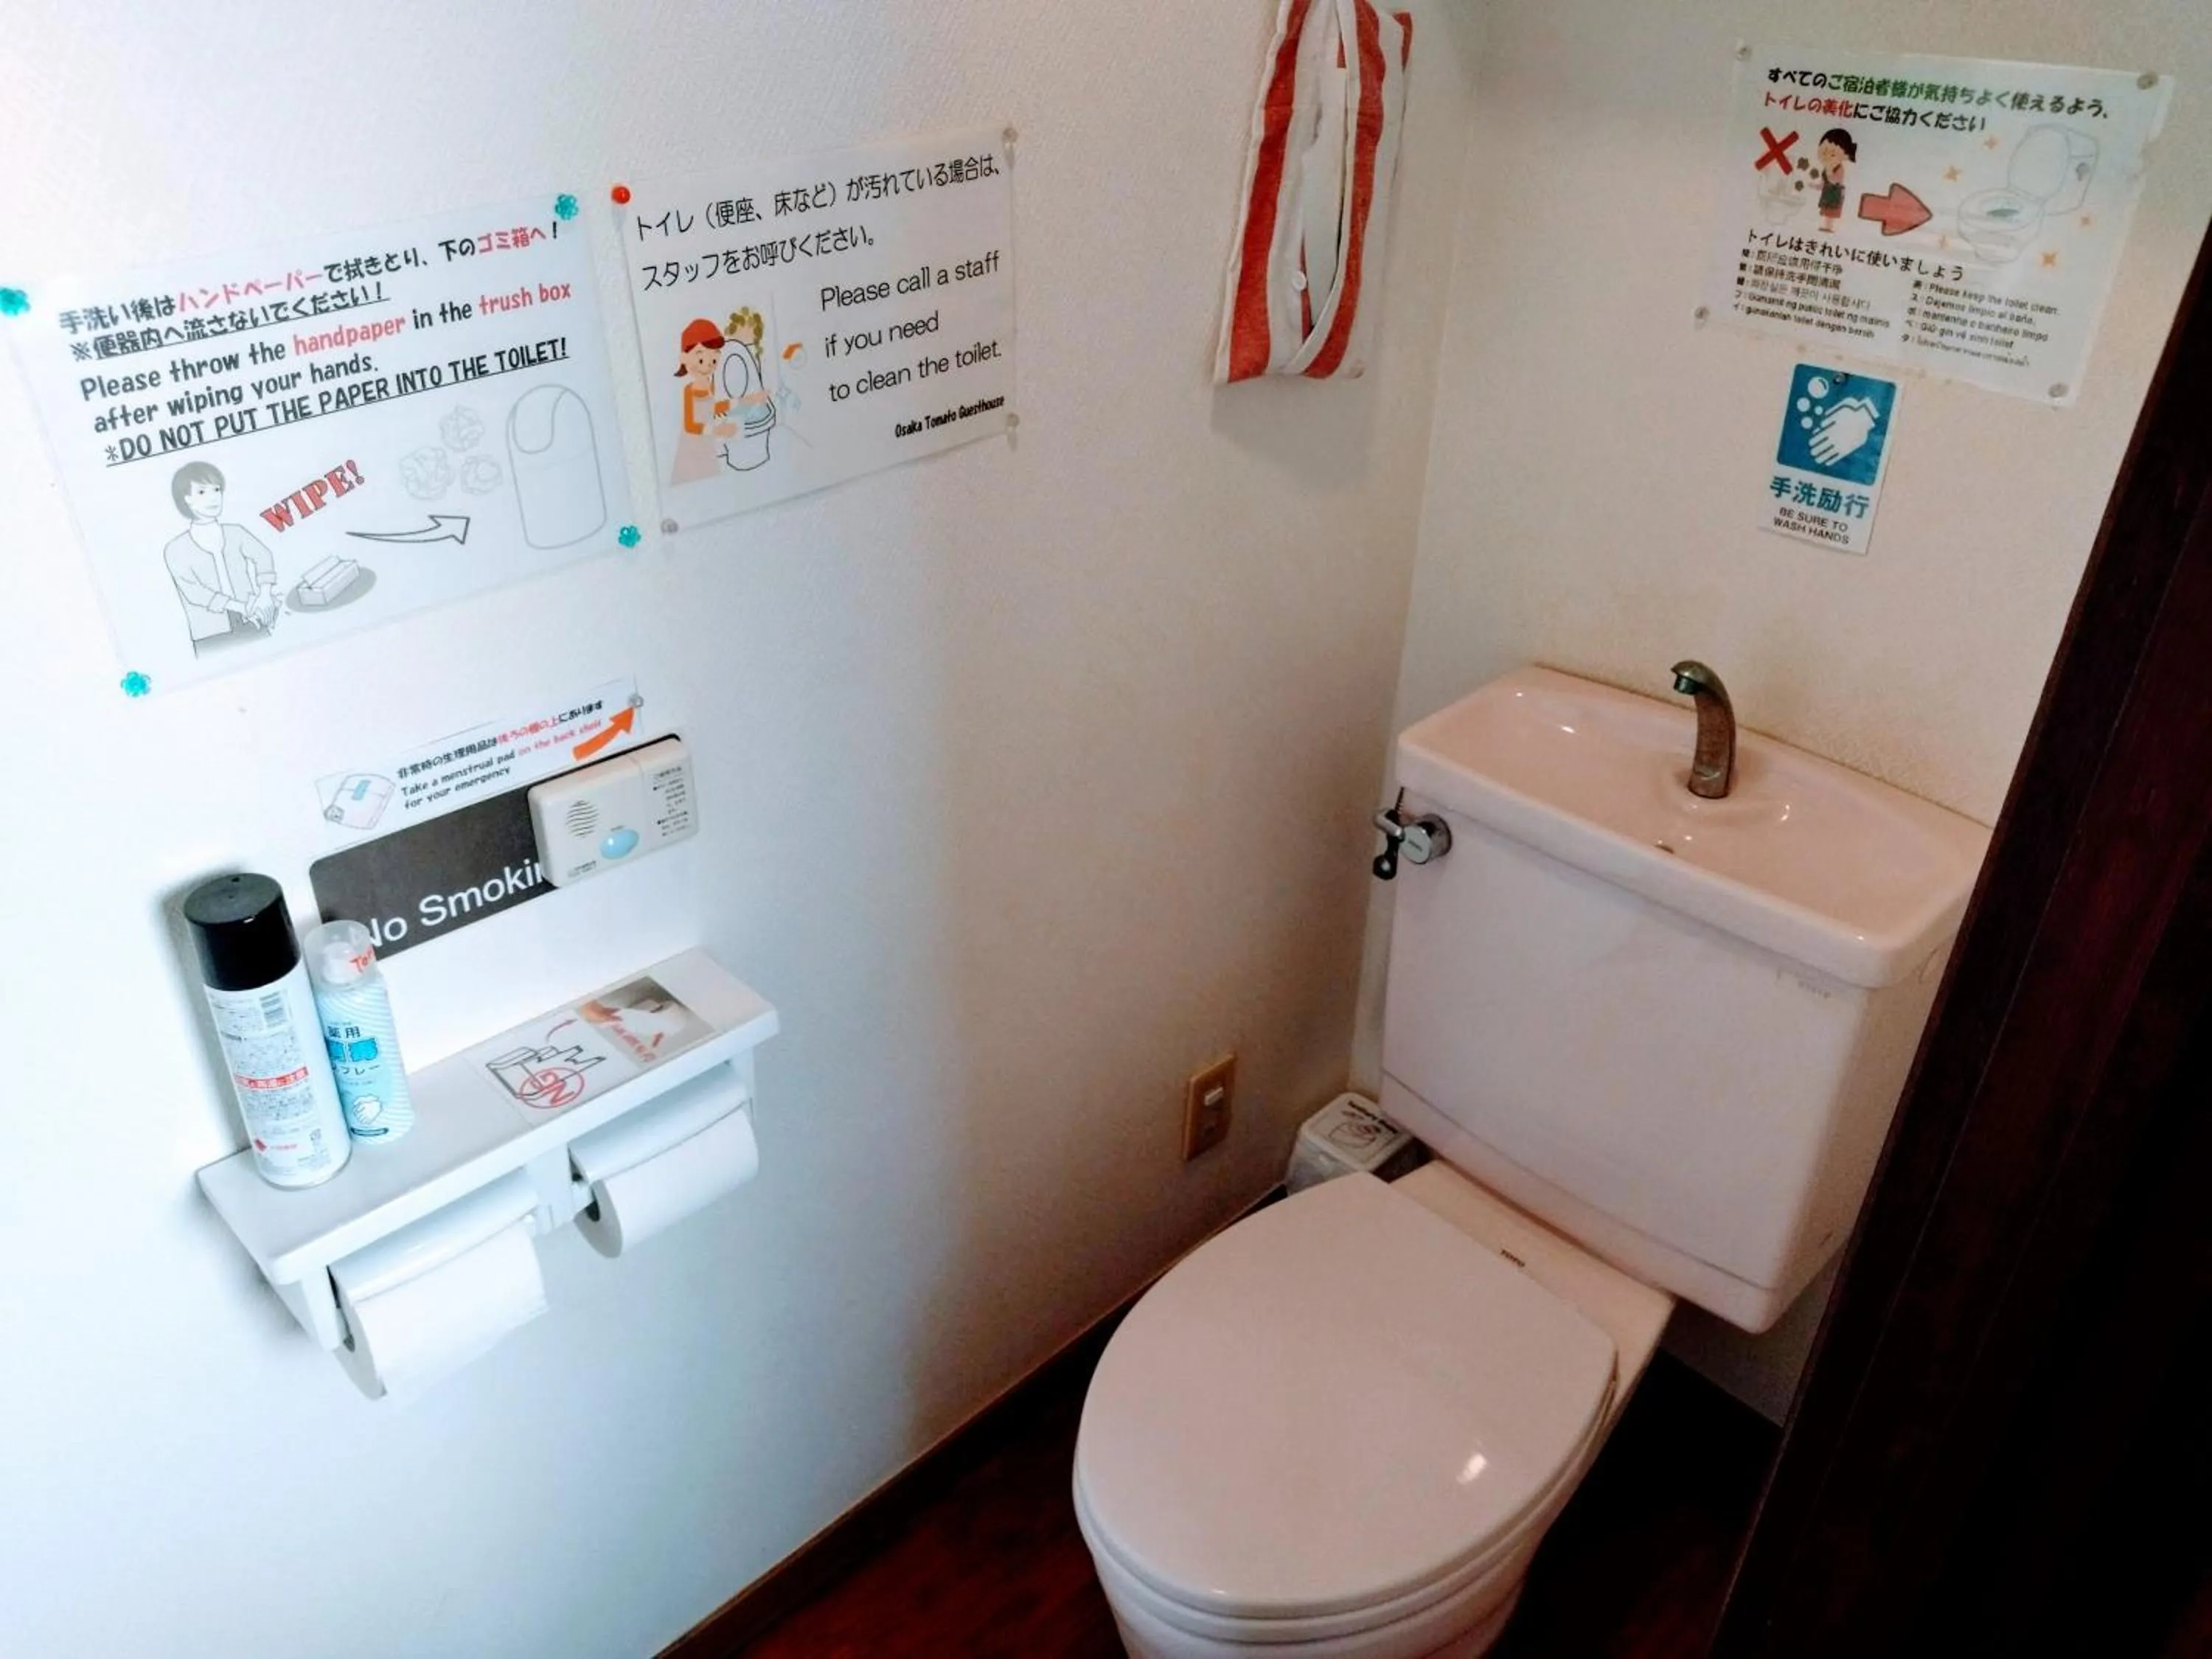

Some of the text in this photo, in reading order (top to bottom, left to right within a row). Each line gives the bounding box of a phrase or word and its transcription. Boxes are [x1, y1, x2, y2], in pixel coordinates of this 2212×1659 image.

[636, 154, 1001, 241] トイレ（便座、床など）が汚れている場合は、
[641, 224, 874, 291] スタッフをお呼びください。
[821, 251, 1000, 311] Please call a staff
[1747, 229, 1964, 281] トイレはきれいに使いましょう
[80, 283, 571, 402] Please throw the handpaper in the trush box
[825, 310, 939, 358] if you need
[94, 353, 378, 433] after wiping your hands.
[159, 420, 204, 451] NOT
[215, 408, 258, 439] PUT
[266, 395, 313, 425] THE
[319, 378, 389, 413] PAPER
[396, 365, 442, 394] INTO
[448, 355, 487, 380] THE
[495, 337, 567, 370] TOILET!
[829, 340, 1002, 402] to clean the toilet.
[895, 395, 1005, 438] Osaka Tomato Guesthouse
[260, 459, 365, 532] WIPE!
[1770, 476, 1869, 518] 手洗励行
[1779, 507, 1848, 532] BE SURE TO
[1773, 517, 1849, 545] WASH HANDS
[401, 782, 428, 797] Take
[431, 779, 439, 787] a
[441, 757, 493, 782] menstrual
[497, 748, 515, 765] pad
[405, 767, 510, 810] for your emergency
